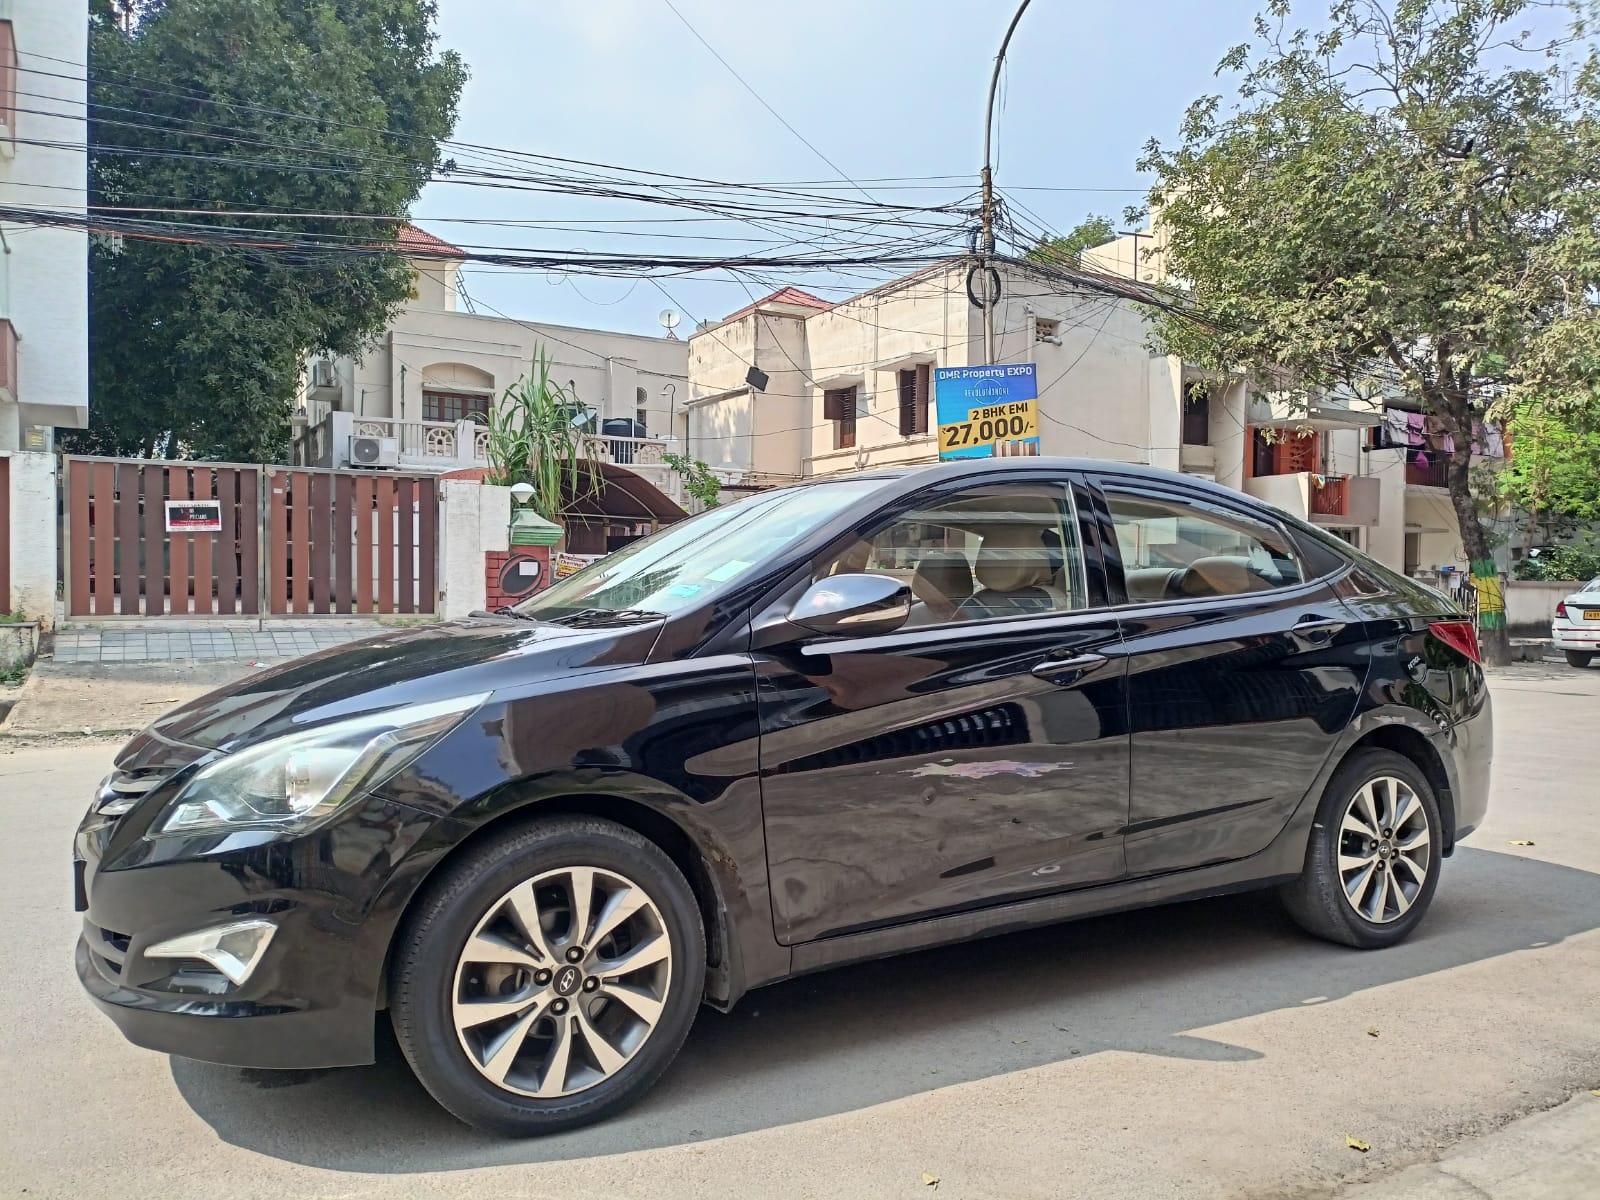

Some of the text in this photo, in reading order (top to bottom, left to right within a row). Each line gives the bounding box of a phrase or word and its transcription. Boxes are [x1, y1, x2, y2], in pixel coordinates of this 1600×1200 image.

[939, 366, 1033, 380] OMR Property EXPO
[972, 402, 1028, 421] 2 BHK EMI
